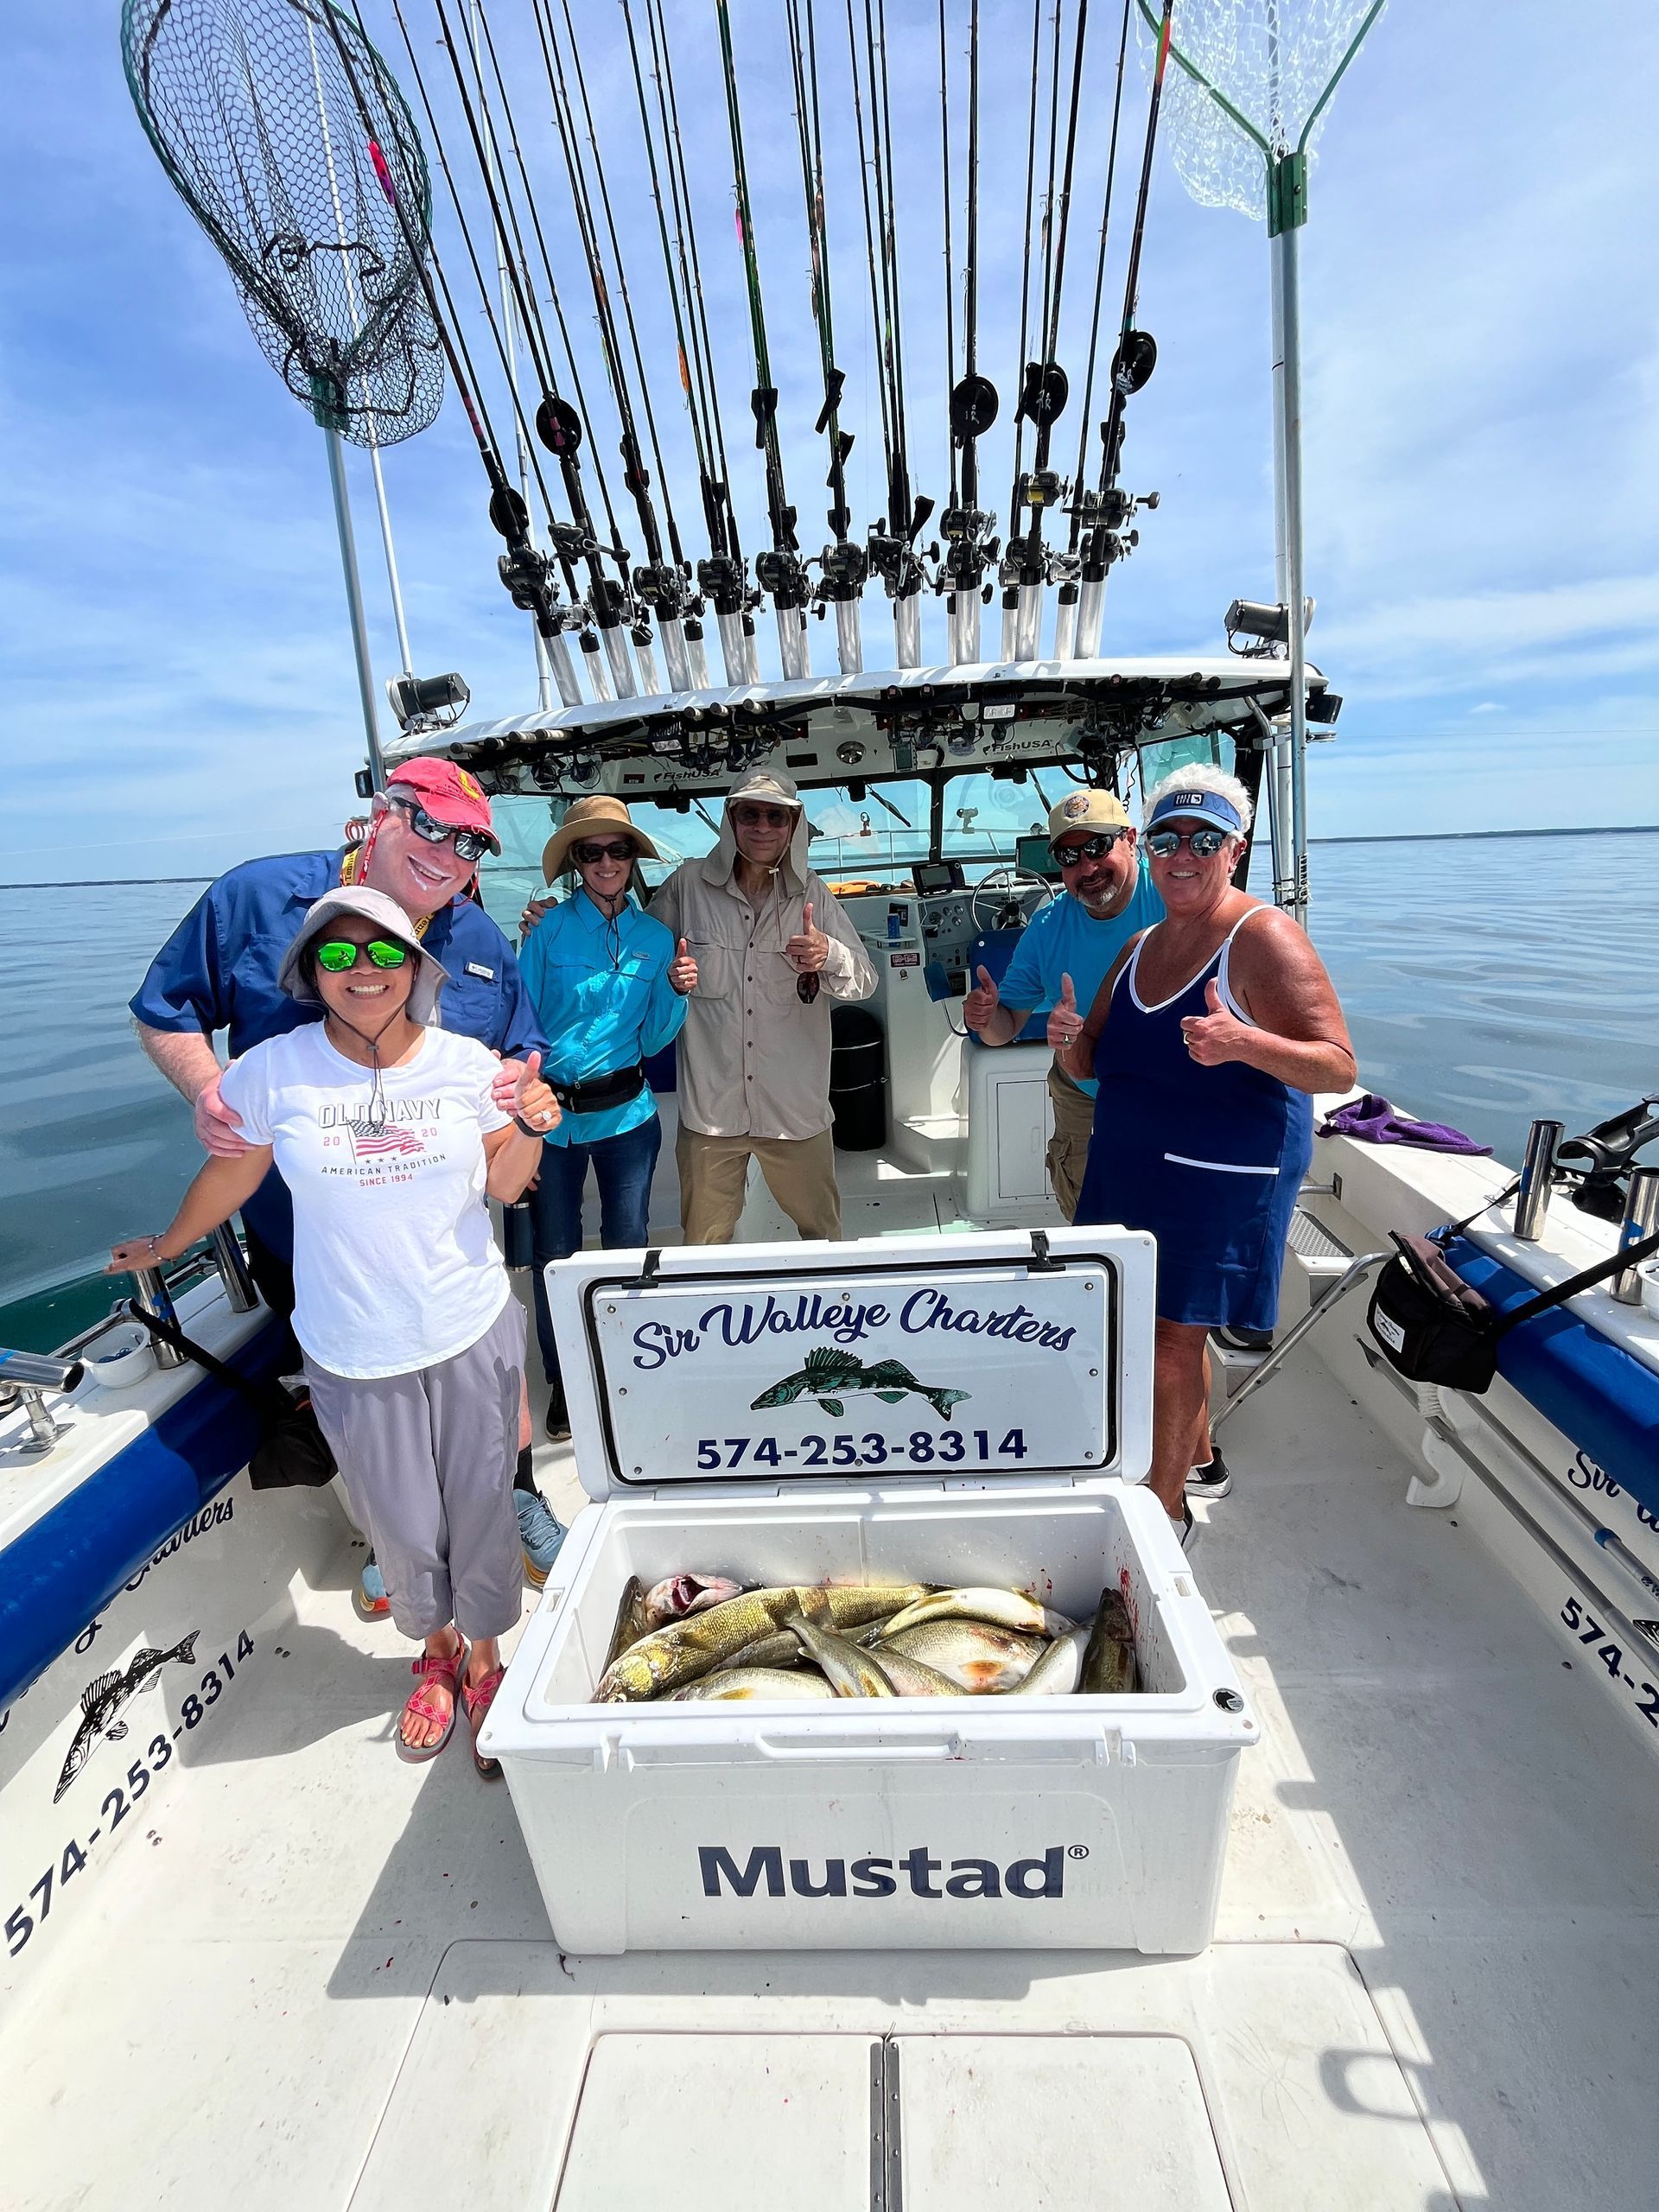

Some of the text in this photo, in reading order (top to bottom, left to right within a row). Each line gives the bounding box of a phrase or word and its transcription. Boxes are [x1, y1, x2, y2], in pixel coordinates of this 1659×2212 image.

[318, 1098, 441, 1128] OLD NAVY
[323, 1136, 340, 1147] 20
[421, 1128, 438, 1138] 20
[321, 1154, 447, 1176] AMERICAN TRADITION
[359, 1173, 414, 1187] SINCE 1994
[632, 1288, 1077, 1370] Sir Walleye Charters
[697, 1428, 1029, 1470] 574-253-8314
[7, 1629, 256, 1957] 574-253-8314
